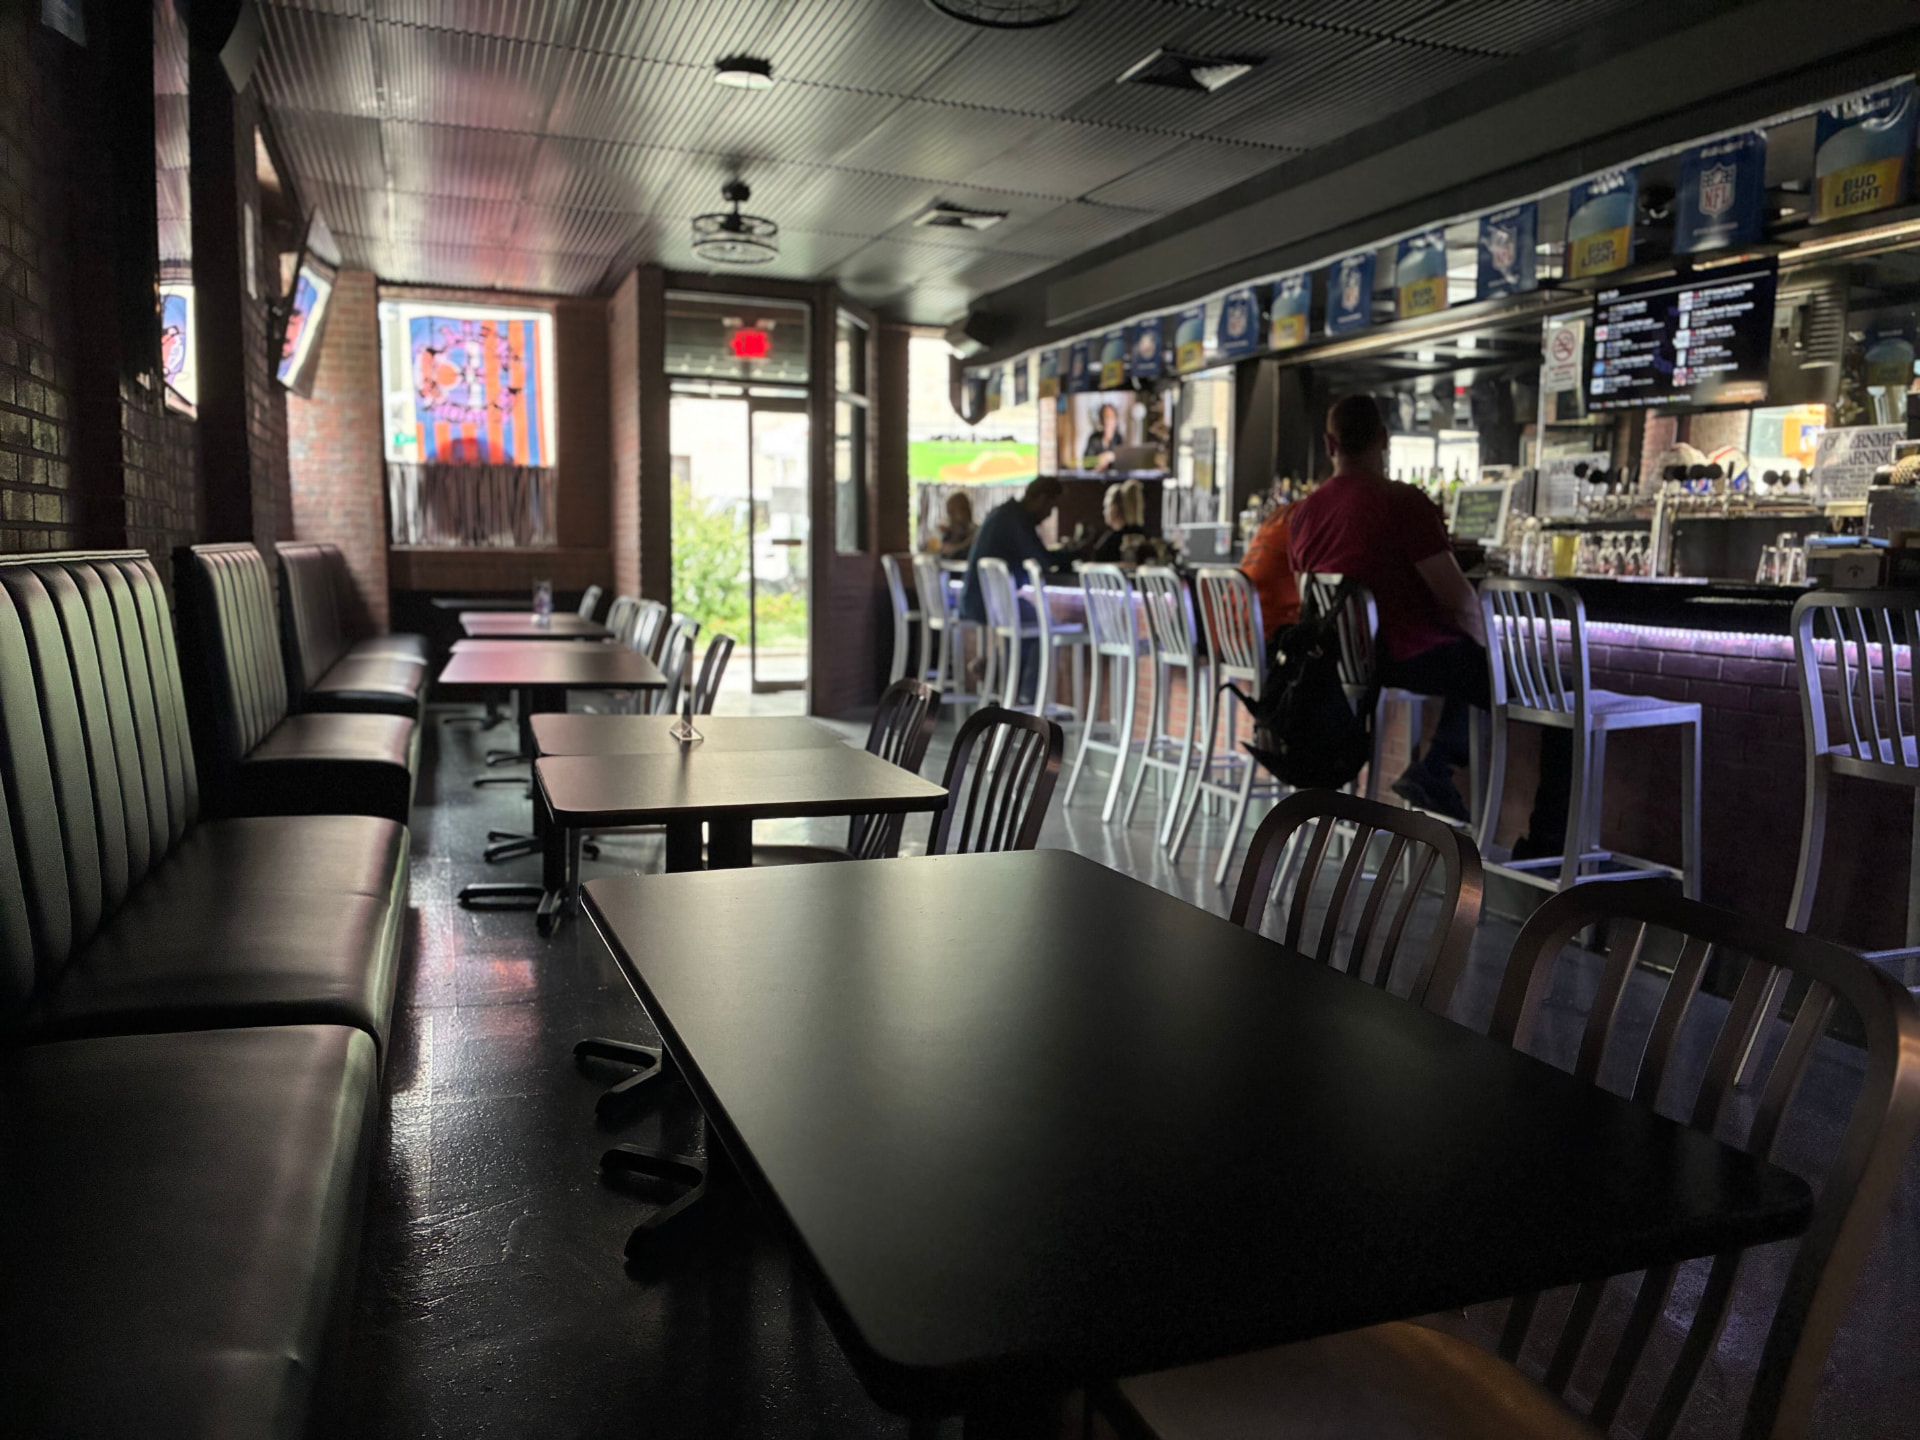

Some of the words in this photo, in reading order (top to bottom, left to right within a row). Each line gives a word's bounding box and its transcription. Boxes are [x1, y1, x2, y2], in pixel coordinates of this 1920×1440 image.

[1843, 173, 1877, 191] BUD
[1705, 184, 1730, 209] NFL
[1834, 185, 1882, 207] LIGHT
[1847, 449, 1890, 466] ARNIN
